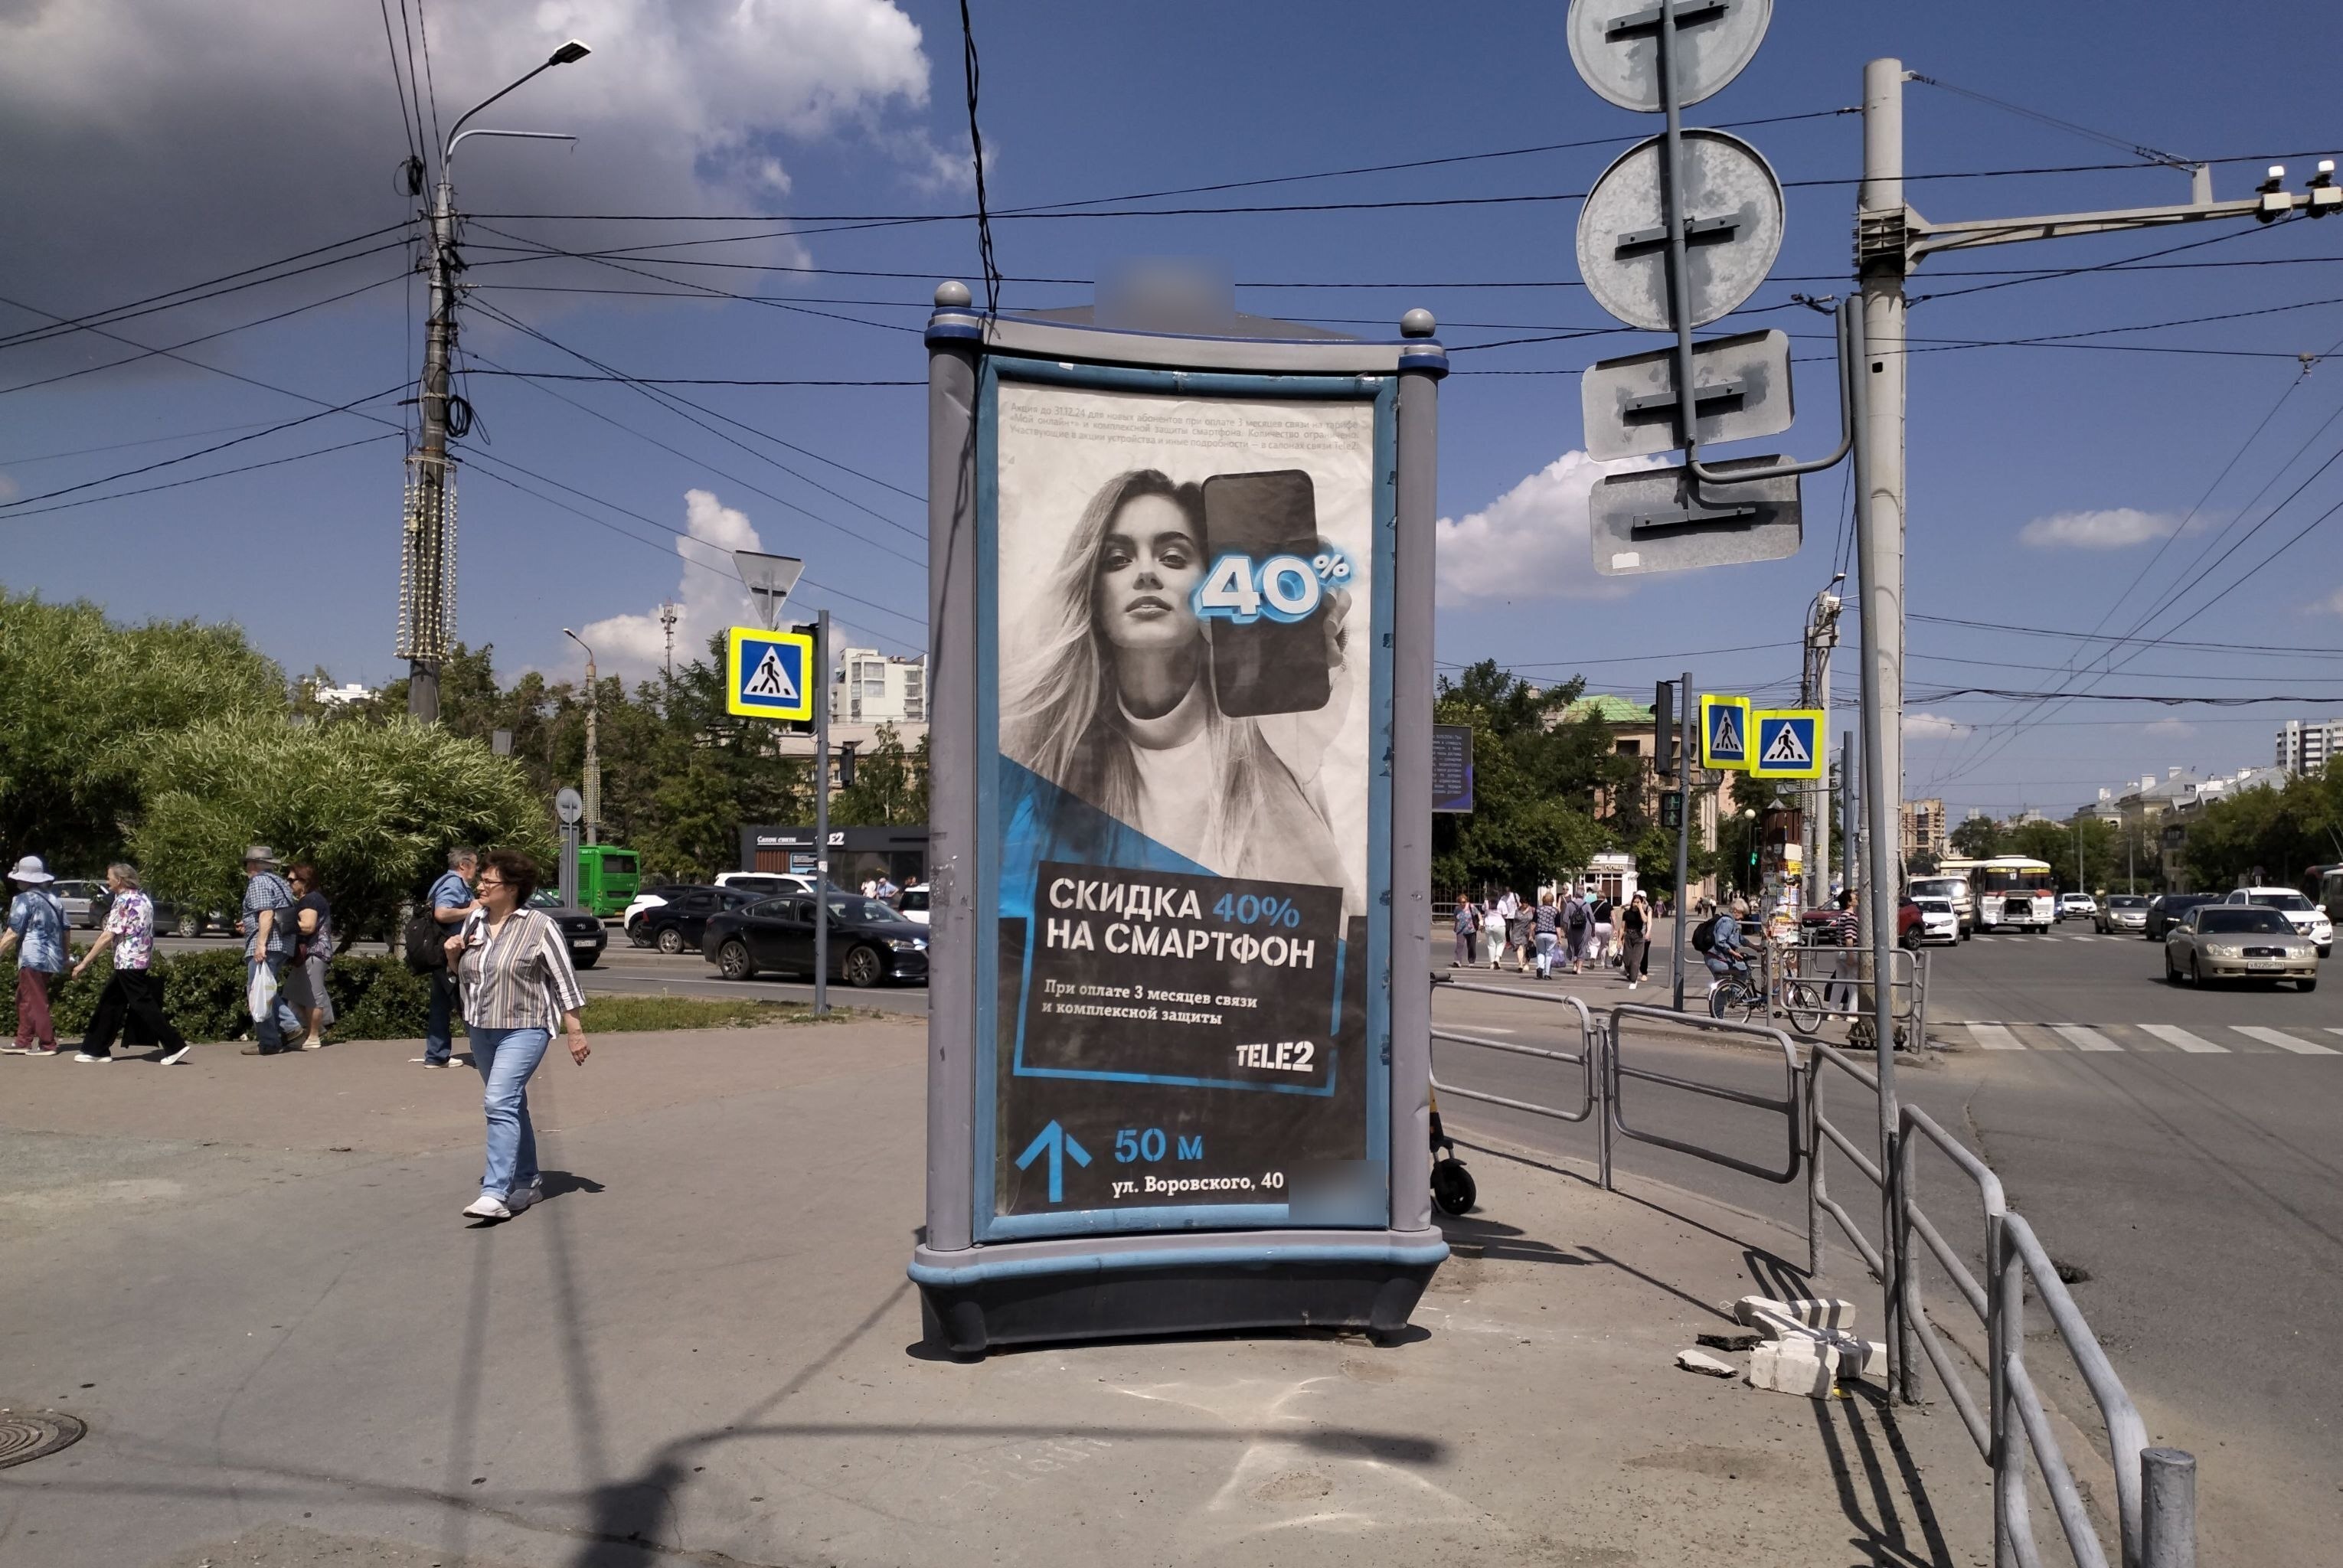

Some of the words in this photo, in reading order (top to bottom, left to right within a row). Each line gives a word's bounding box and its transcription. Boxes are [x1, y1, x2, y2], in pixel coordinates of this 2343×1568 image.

[1010, 402, 1038, 413] Акция
[1040, 407, 1052, 416] до
[1054, 406, 1085, 417] 31.12.24
[1136, 413, 1183, 424] абонентов
[1185, 417, 1202, 426] при
[1238, 418, 1243, 427] 3
[1246, 420, 1283, 429] месяцев
[1285, 420, 1309, 429] связи
[1325, 420, 1358, 430] тарифе
[1093, 422, 1151, 433] комплексной
[1154, 426, 1188, 435] защиты
[1248, 428, 1299, 439] Количество
[1009, 424, 1070, 439] Участвующие
[1078, 433, 1105, 442] акции
[1107, 434, 1156, 446] устройства
[1191, 438, 1249, 449] подробности
[1194, 554, 1351, 623] 40%
[1047, 877, 1202, 922] СКИДКА
[1212, 893, 1301, 929] 40%
[1046, 916, 1095, 952] НА
[1103, 923, 1316, 969] СМАРТФОН
[1044, 978, 1076, 999] При
[1078, 984, 1131, 1000] оплате
[1134, 985, 1144, 1000] 3
[1146, 988, 1212, 1007] месяцев
[1214, 994, 1258, 1009] связи
[1041, 1001, 1052, 1013] и
[1056, 1002, 1158, 1021] комплексной
[1161, 1008, 1223, 1026] защиты
[1235, 1040, 1315, 1073] TELE2
[1114, 1127, 1167, 1164] 50
[1111, 1178, 1139, 1200] ул.
[1143, 1174, 1256, 1197] Воровского,
[1260, 1171, 1285, 1190] 40
